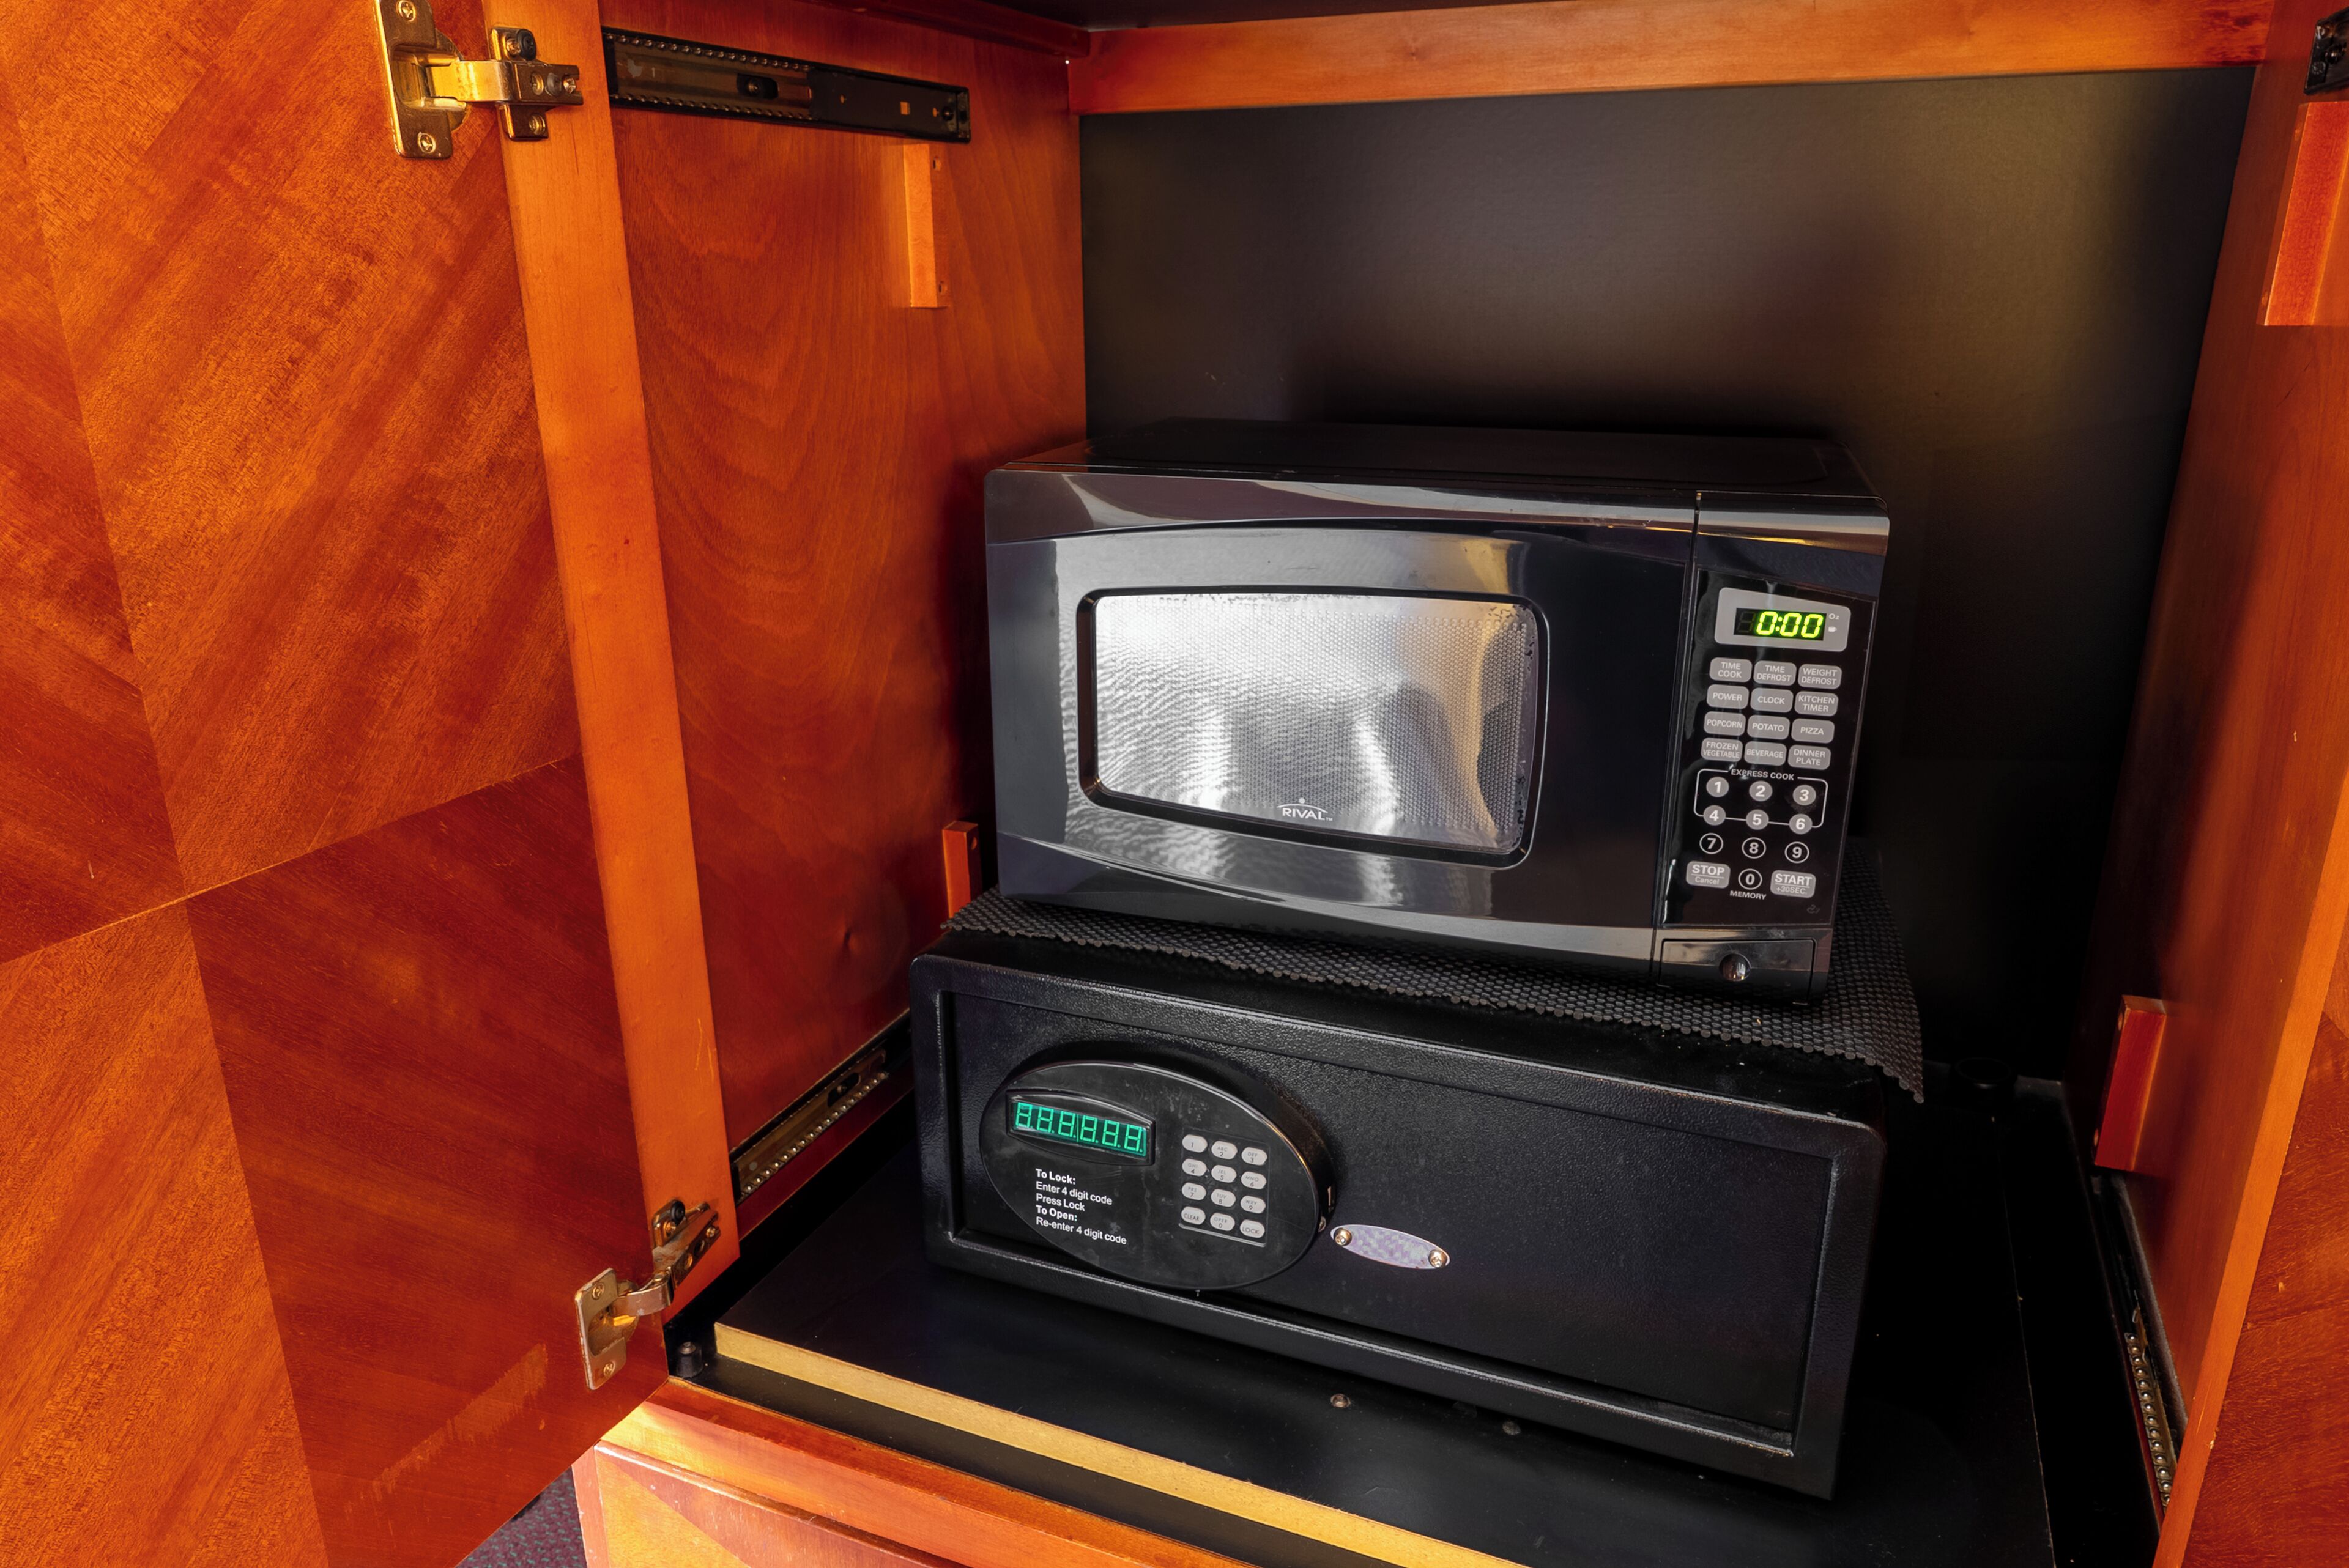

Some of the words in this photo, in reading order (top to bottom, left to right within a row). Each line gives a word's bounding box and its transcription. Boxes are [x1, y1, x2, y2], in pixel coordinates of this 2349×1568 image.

[1756, 611, 1824, 638] 0:00
[1718, 670, 1742, 678] COOK
[1765, 665, 1785, 673] TIME
[1803, 668, 1837, 677] WEIGHT
[1757, 673, 1792, 682] DEFROST
[1801, 676, 1836, 686] DEFROST
[1713, 692, 1742, 701] POWER
[1757, 696, 1785, 704] CLOCK
[1798, 695, 1835, 704] KITCHEN
[1803, 703, 1828, 712] TIMER
[1707, 719, 1743, 728] POPCORN
[1752, 723, 1784, 732] POTATO
[1800, 727, 1824, 735] PIZZA
[1706, 741, 1739, 750] FROZEN
[1703, 749, 1740, 759] VEGETABLE
[1746, 749, 1784, 759] BEVERAGE
[1794, 749, 1825, 758] DINNER
[1796, 757, 1821, 766] PLATE
[1731, 768, 1768, 778] EXPRESS
[1770, 772, 1794, 781] COOK
[1714, 781, 1721, 793] 1
[1756, 785, 1765, 797] 2
[1799, 789, 1809, 801] 3
[1282, 808, 1325, 821] RIVAL
[1709, 810, 1719, 821] 4
[1753, 814, 1762, 825] 5
[1795, 818, 1805, 830] 6
[1707, 838, 1716, 849] 7
[1749, 842, 1759, 854] 8
[1792, 846, 1802, 859] 9
[1692, 864, 1725, 876] STOP
[1695, 876, 1720, 885] Cancel
[1746, 873, 1755, 885] 0
[1775, 874, 1813, 886] START
[1730, 890, 1767, 900] MEMORY
[1036, 1168, 1047, 1178] To
[1049, 1171, 1075, 1185] Lock:
[1036, 1181, 1060, 1193] Enter
[1069, 1189, 1089, 1200] digit
[1090, 1194, 1113, 1205] code
[1036, 1193, 1062, 1206] Press
[1063, 1199, 1085, 1211] Lock
[1036, 1205, 1047, 1215] To
[1049, 1208, 1077, 1221] Open:
[1036, 1216, 1074, 1232] Re-enter
[1084, 1228, 1103, 1240] digit
[1104, 1233, 1127, 1244] code
